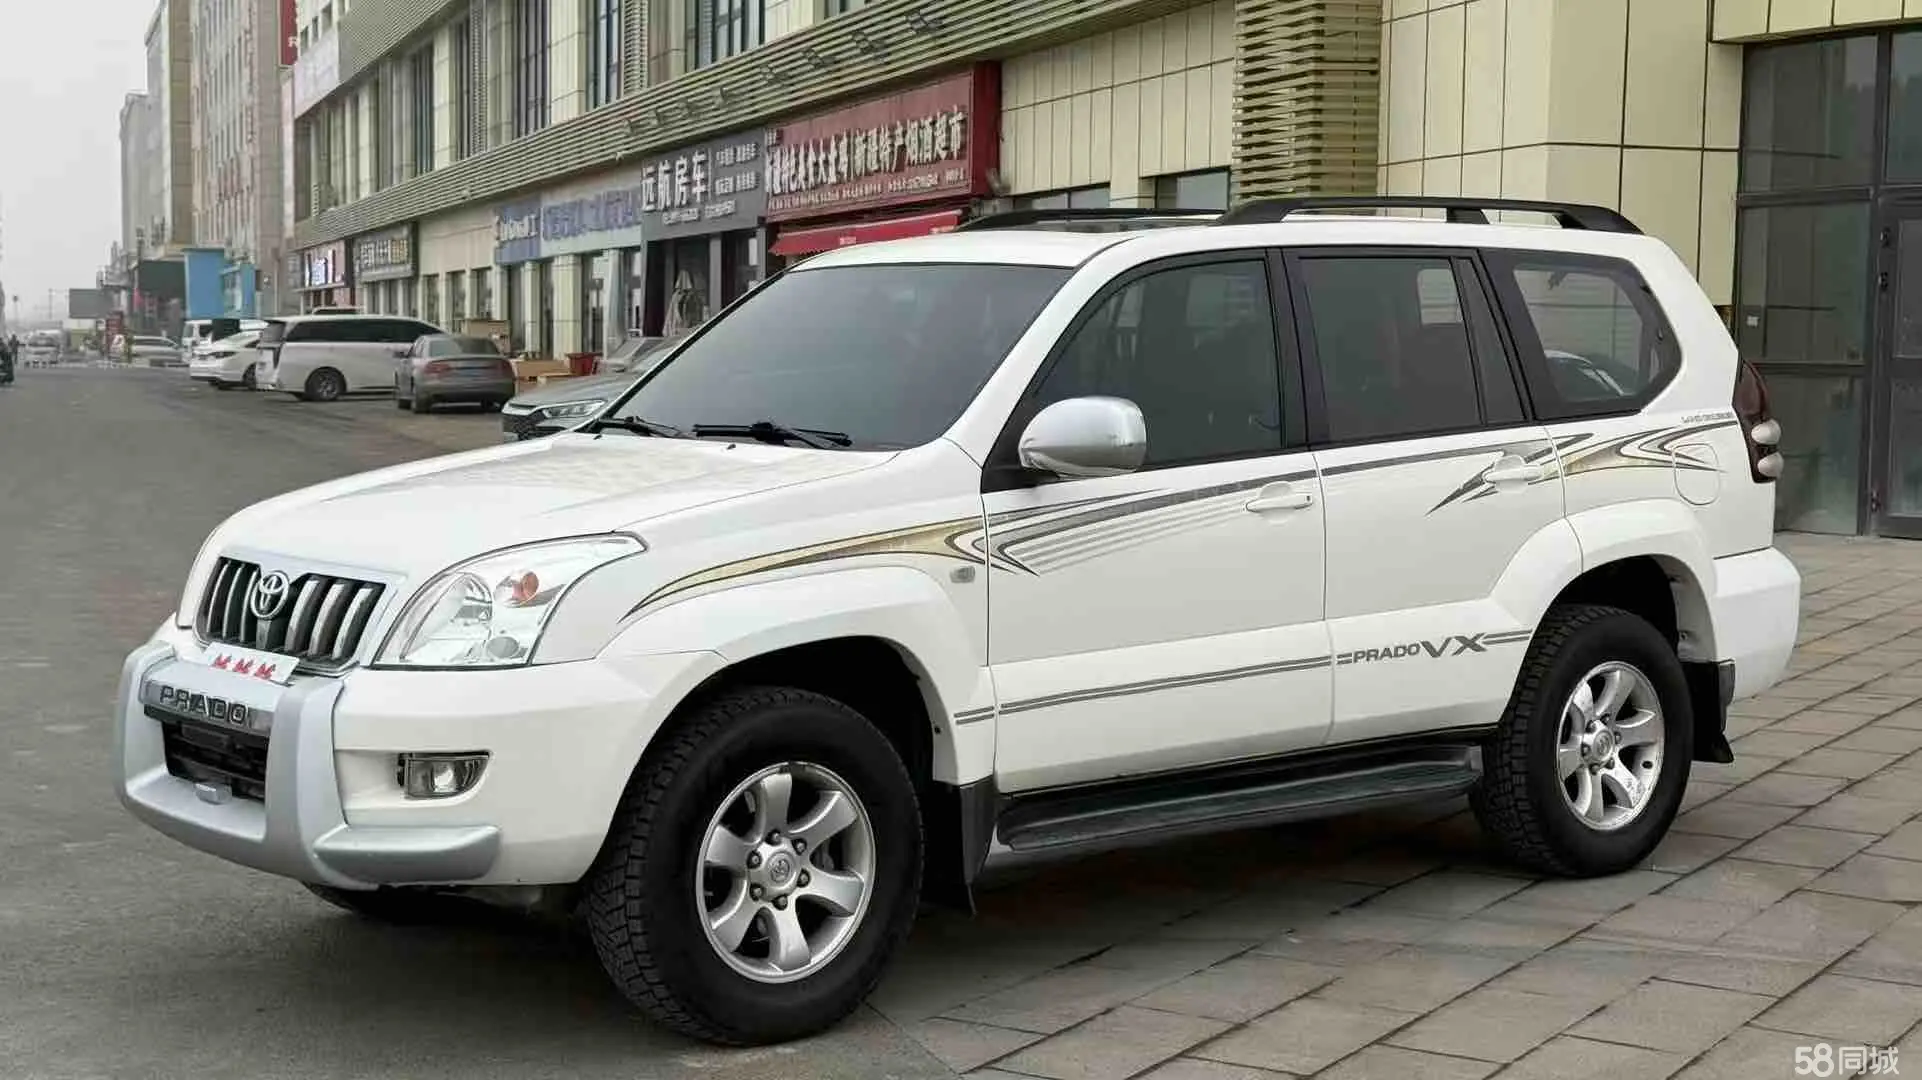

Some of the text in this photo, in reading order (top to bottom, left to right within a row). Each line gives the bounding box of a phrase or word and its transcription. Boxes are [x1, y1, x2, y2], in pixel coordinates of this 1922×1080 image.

[642, 150, 706, 211] 远航房车
[1353, 632, 1487, 663] PRADO VX
[160, 686, 249, 724] PRADO
